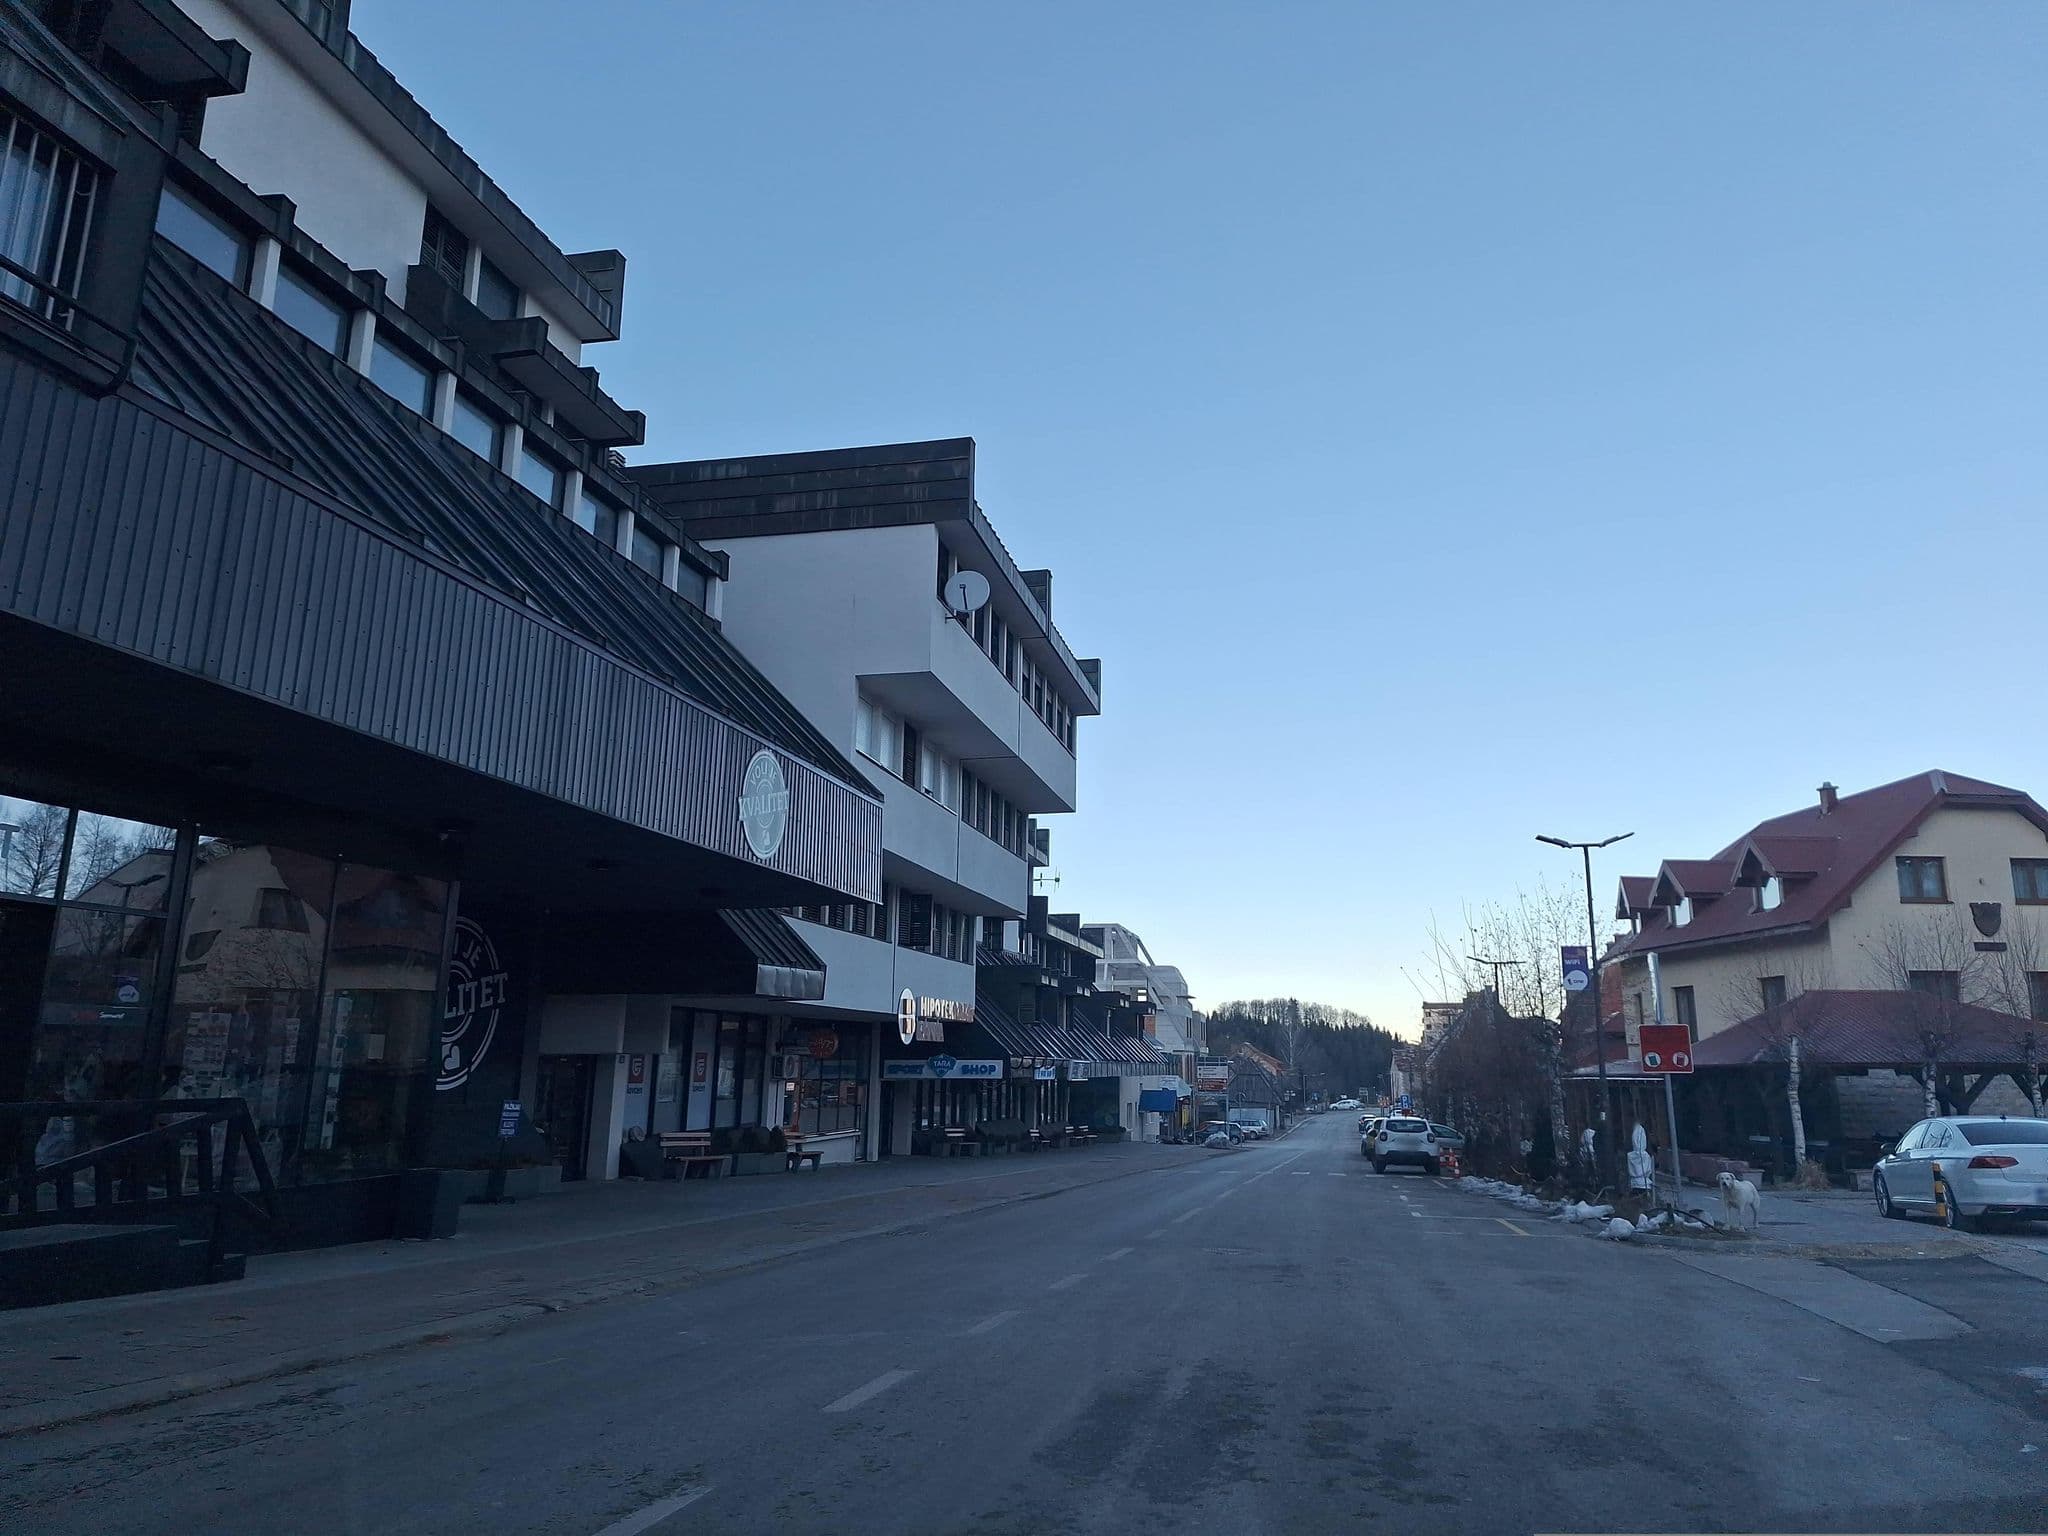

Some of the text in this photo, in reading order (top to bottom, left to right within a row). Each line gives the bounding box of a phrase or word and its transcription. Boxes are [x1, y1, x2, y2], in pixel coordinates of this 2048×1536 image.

[738, 790, 790, 821] KVALITET
[444, 972, 508, 1019] LITET
[961, 1064, 996, 1075] SHOP
